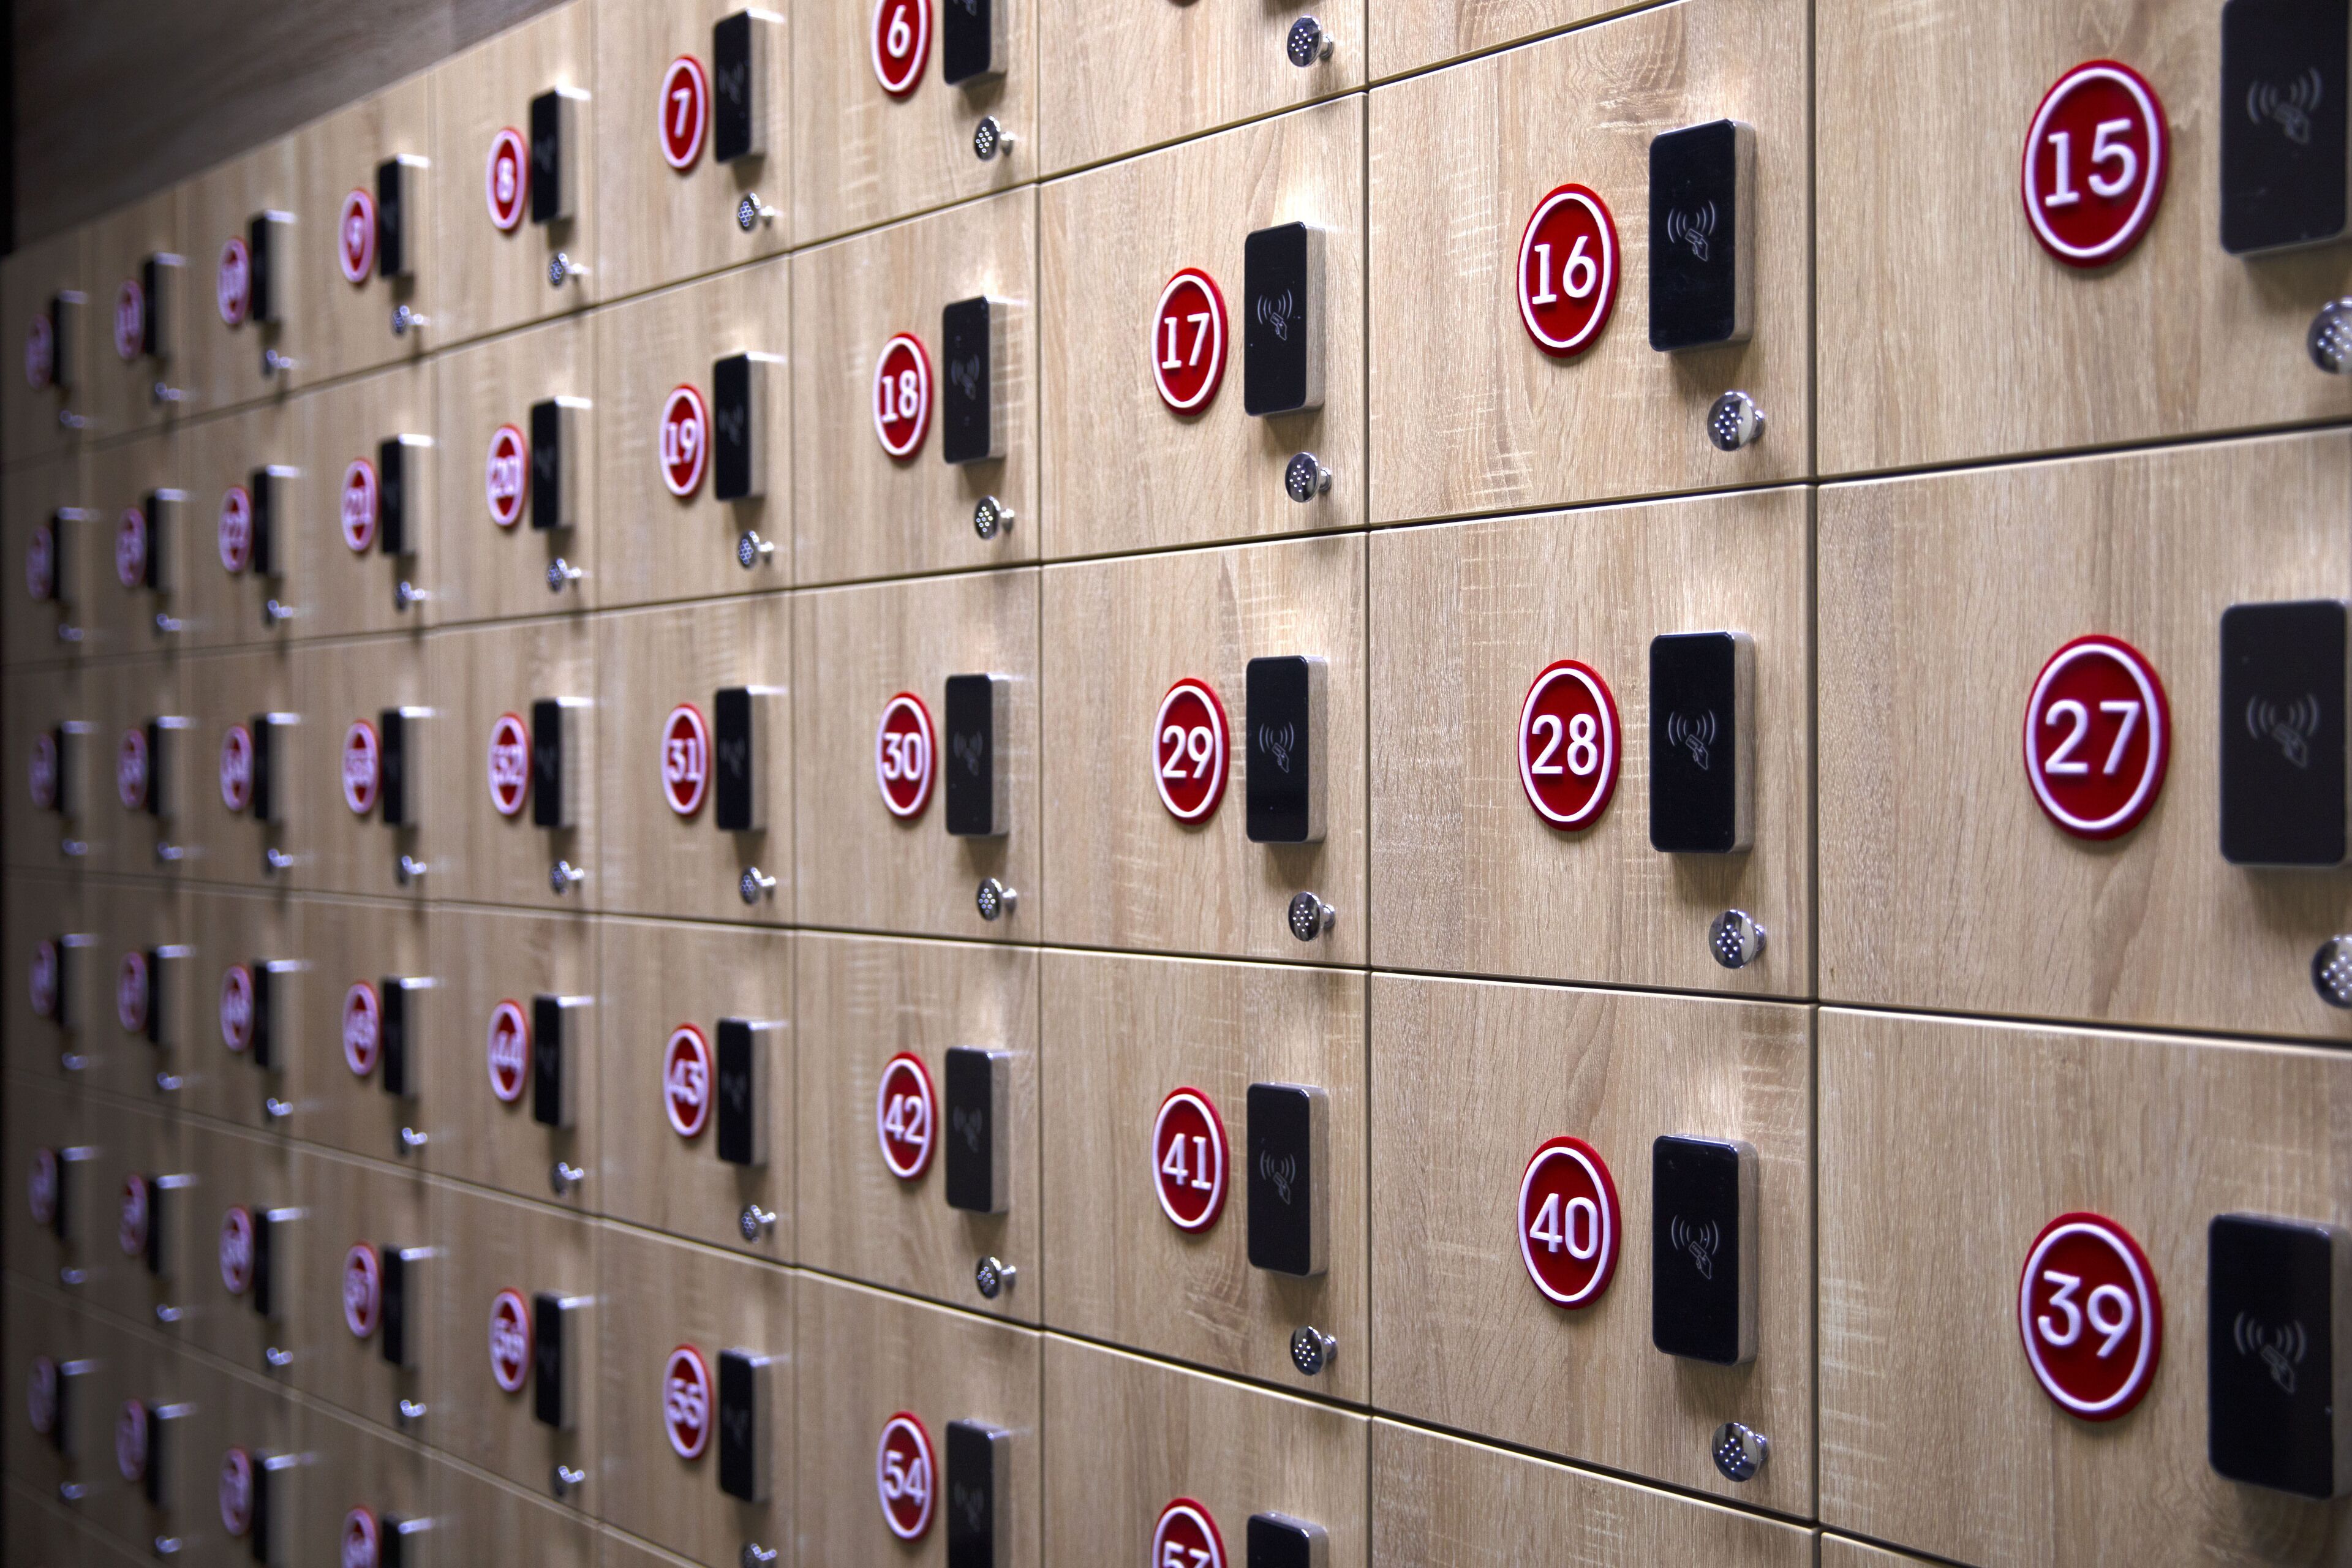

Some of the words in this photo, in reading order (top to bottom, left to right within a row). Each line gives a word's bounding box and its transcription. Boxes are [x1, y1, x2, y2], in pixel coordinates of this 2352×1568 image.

[888, 5, 911, 58] 6
[671, 88, 692, 137] 7
[2045, 118, 2136, 207] 15
[1531, 236, 1597, 305] 16
[1161, 312, 1210, 369] 17
[882, 370, 919, 423] 18
[665, 418, 697, 466] 19
[667, 738, 701, 784] 31
[884, 732, 923, 781] 30
[1161, 725, 1214, 778] 29
[1531, 713, 1598, 775] 28
[2045, 699, 2139, 774] 27
[884, 1093, 924, 1145] 42
[1161, 1133, 1212, 1190] 41
[1529, 1193, 1598, 1259] 40
[2037, 1270, 2133, 1357] 39
[884, 1450, 926, 1507] 54
